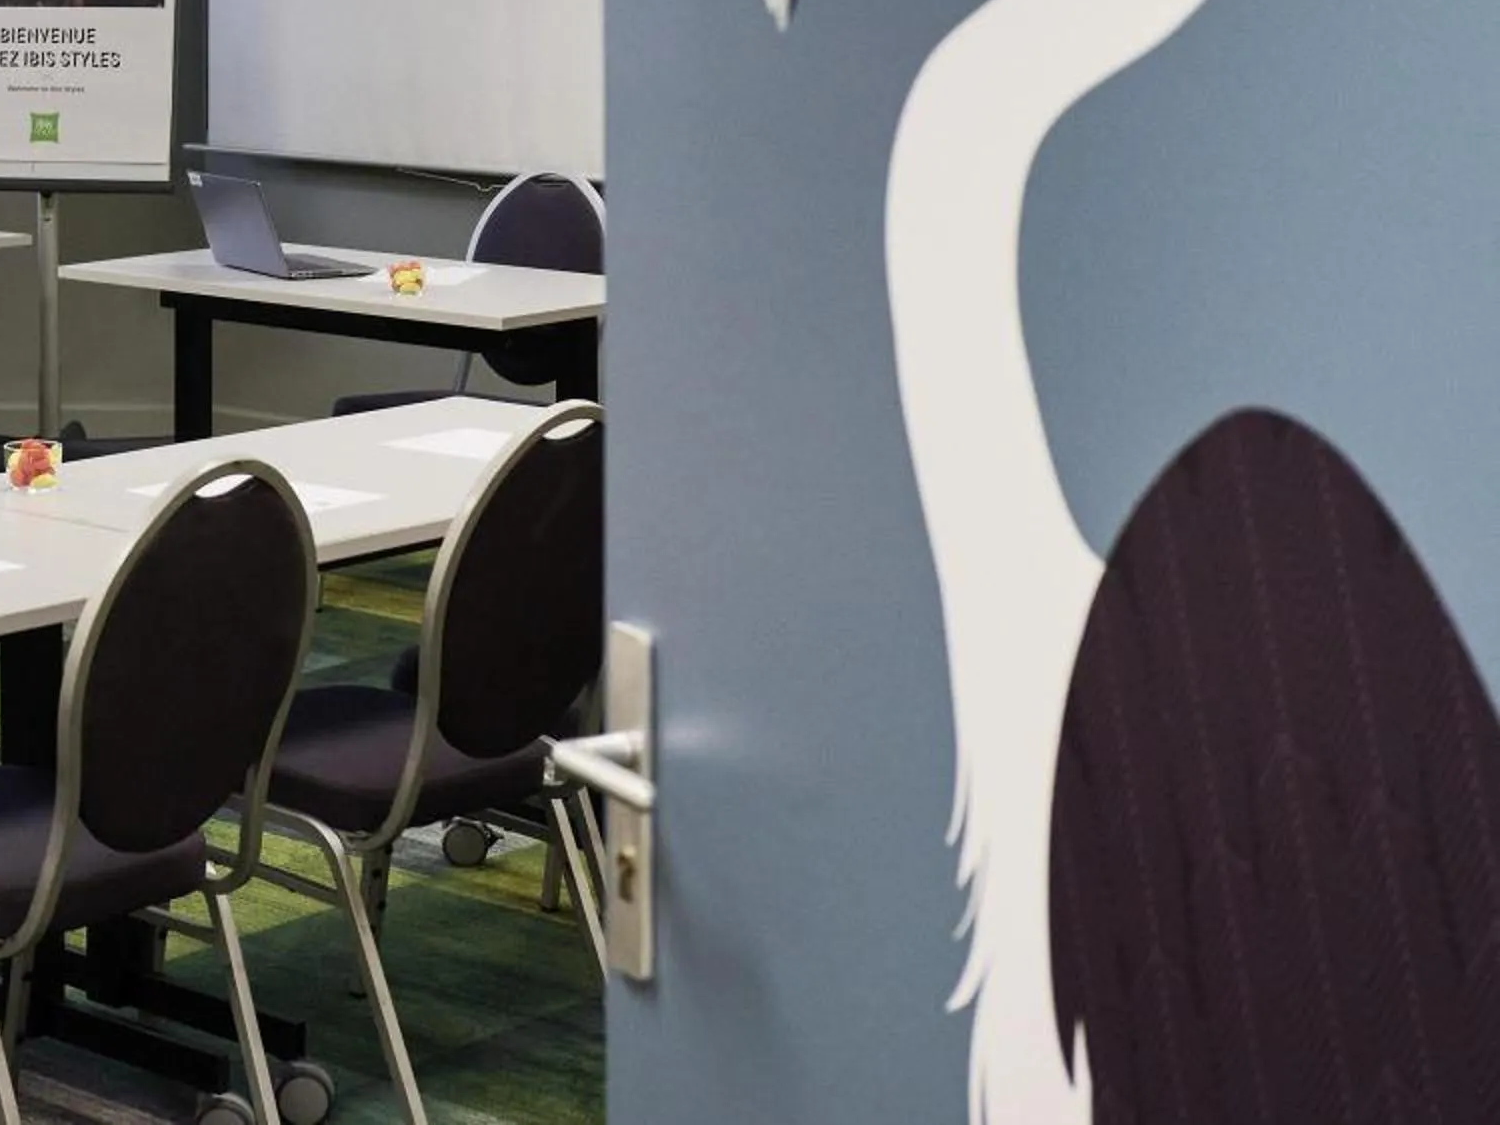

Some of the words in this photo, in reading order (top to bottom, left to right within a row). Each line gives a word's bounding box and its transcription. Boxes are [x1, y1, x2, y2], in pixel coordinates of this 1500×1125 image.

[0, 27, 97, 44] BIENVENUE
[23, 50, 56, 68] IBIS
[60, 51, 121, 68] STYLES
